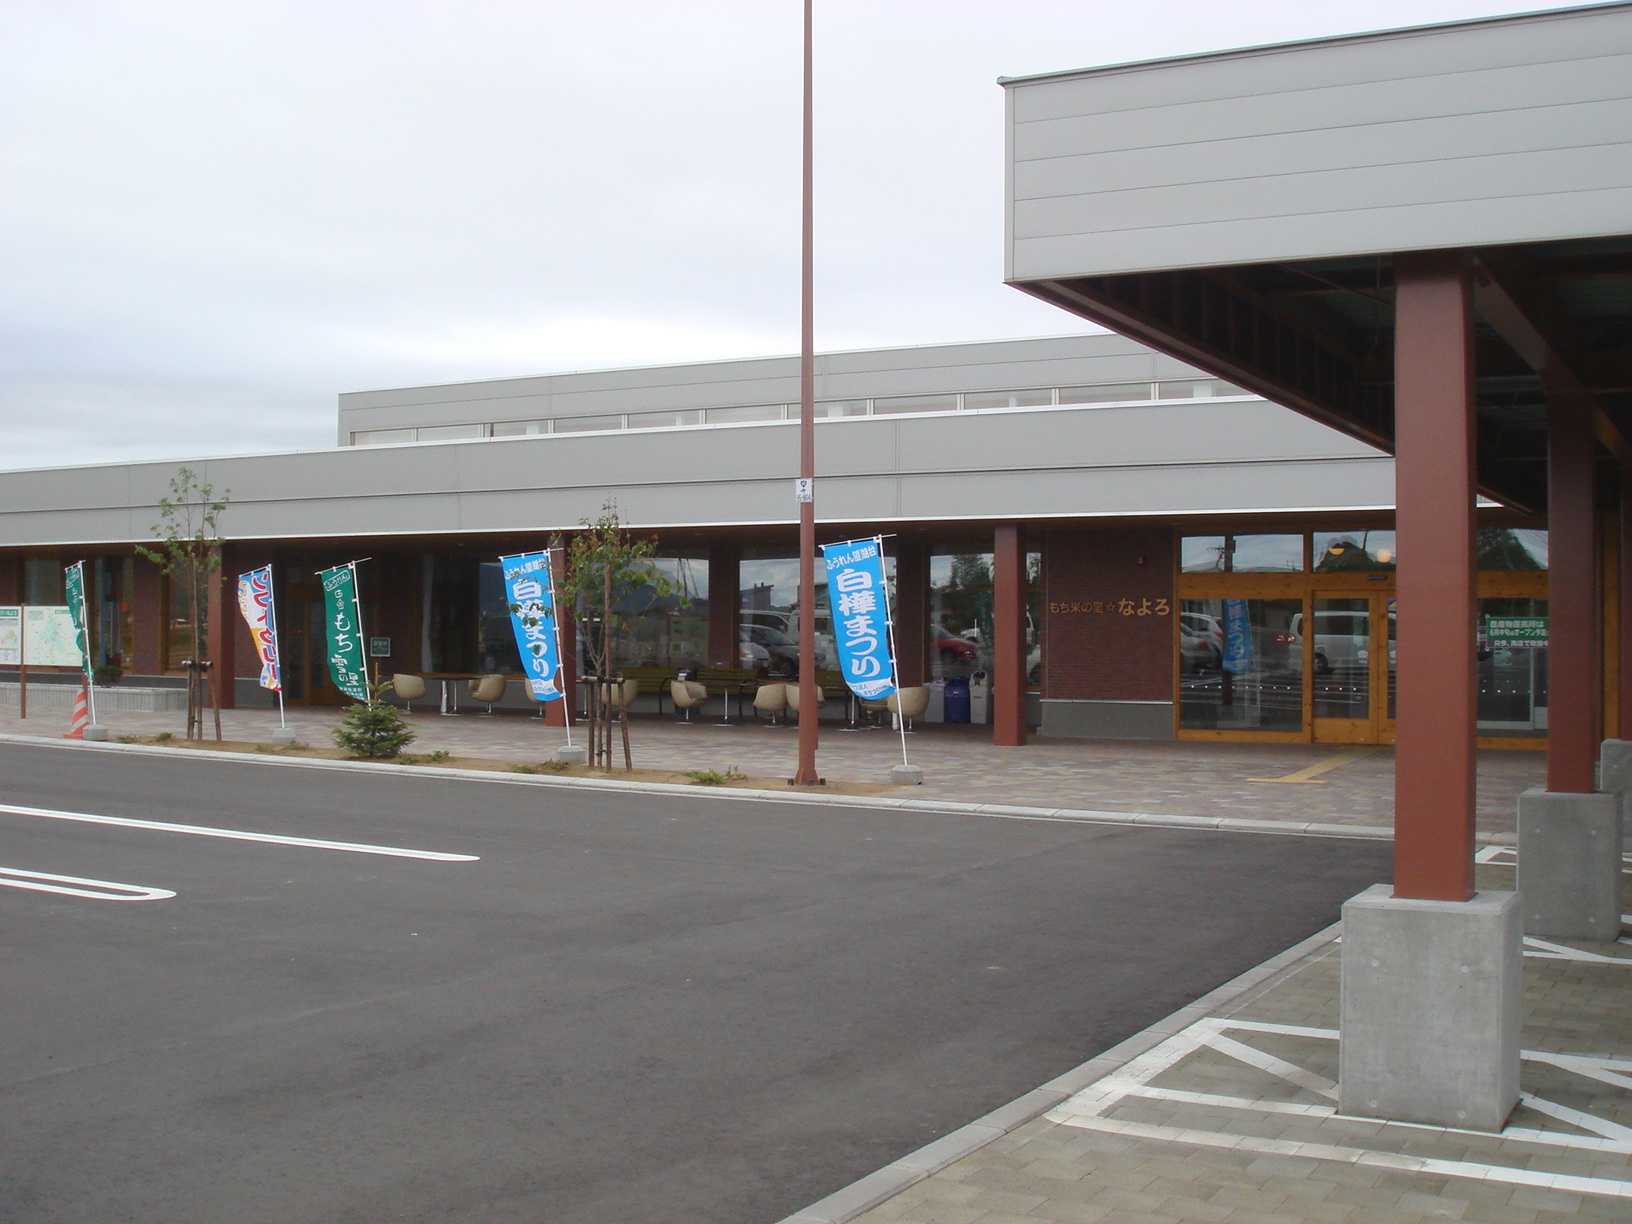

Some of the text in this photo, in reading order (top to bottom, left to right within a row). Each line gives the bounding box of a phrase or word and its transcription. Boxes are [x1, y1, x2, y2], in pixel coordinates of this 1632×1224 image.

[826, 545, 877, 570] ふうれん望湖台
[836, 568, 881, 678] 白樺まつり
